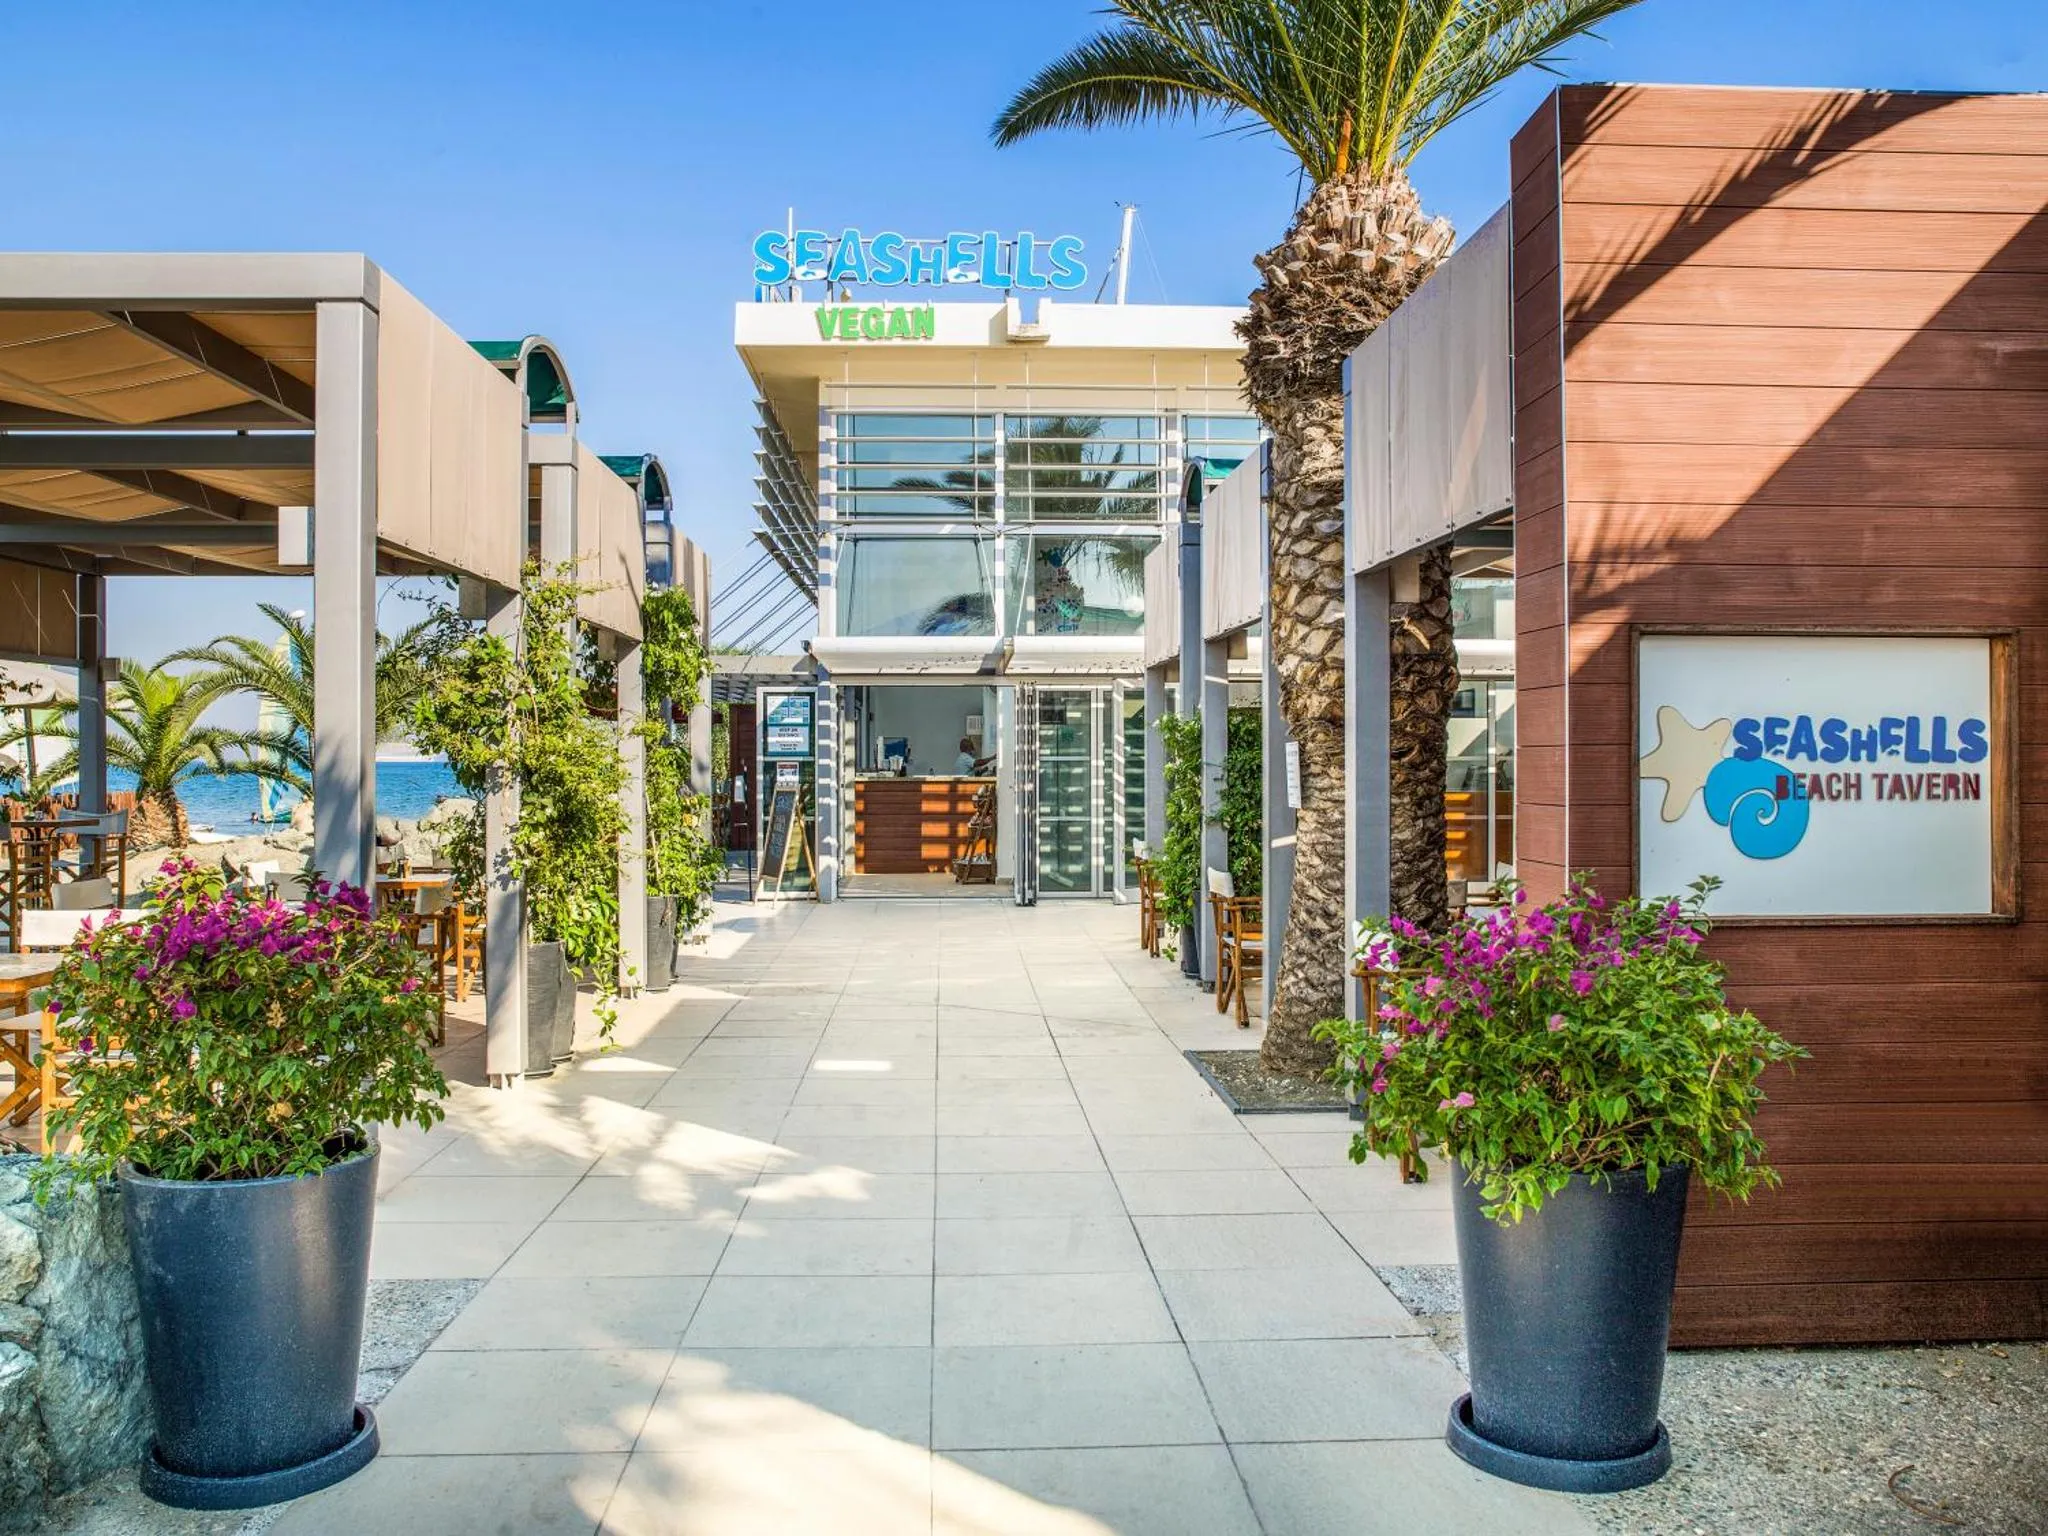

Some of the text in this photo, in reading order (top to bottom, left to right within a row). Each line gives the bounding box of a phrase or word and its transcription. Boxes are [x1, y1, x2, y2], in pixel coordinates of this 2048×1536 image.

[753, 229, 1087, 290] SEASHELLS
[816, 306, 935, 341] VEGAN
[1732, 715, 1988, 764] SEASHELLS
[1775, 772, 1981, 801] BEACH TAVERN
